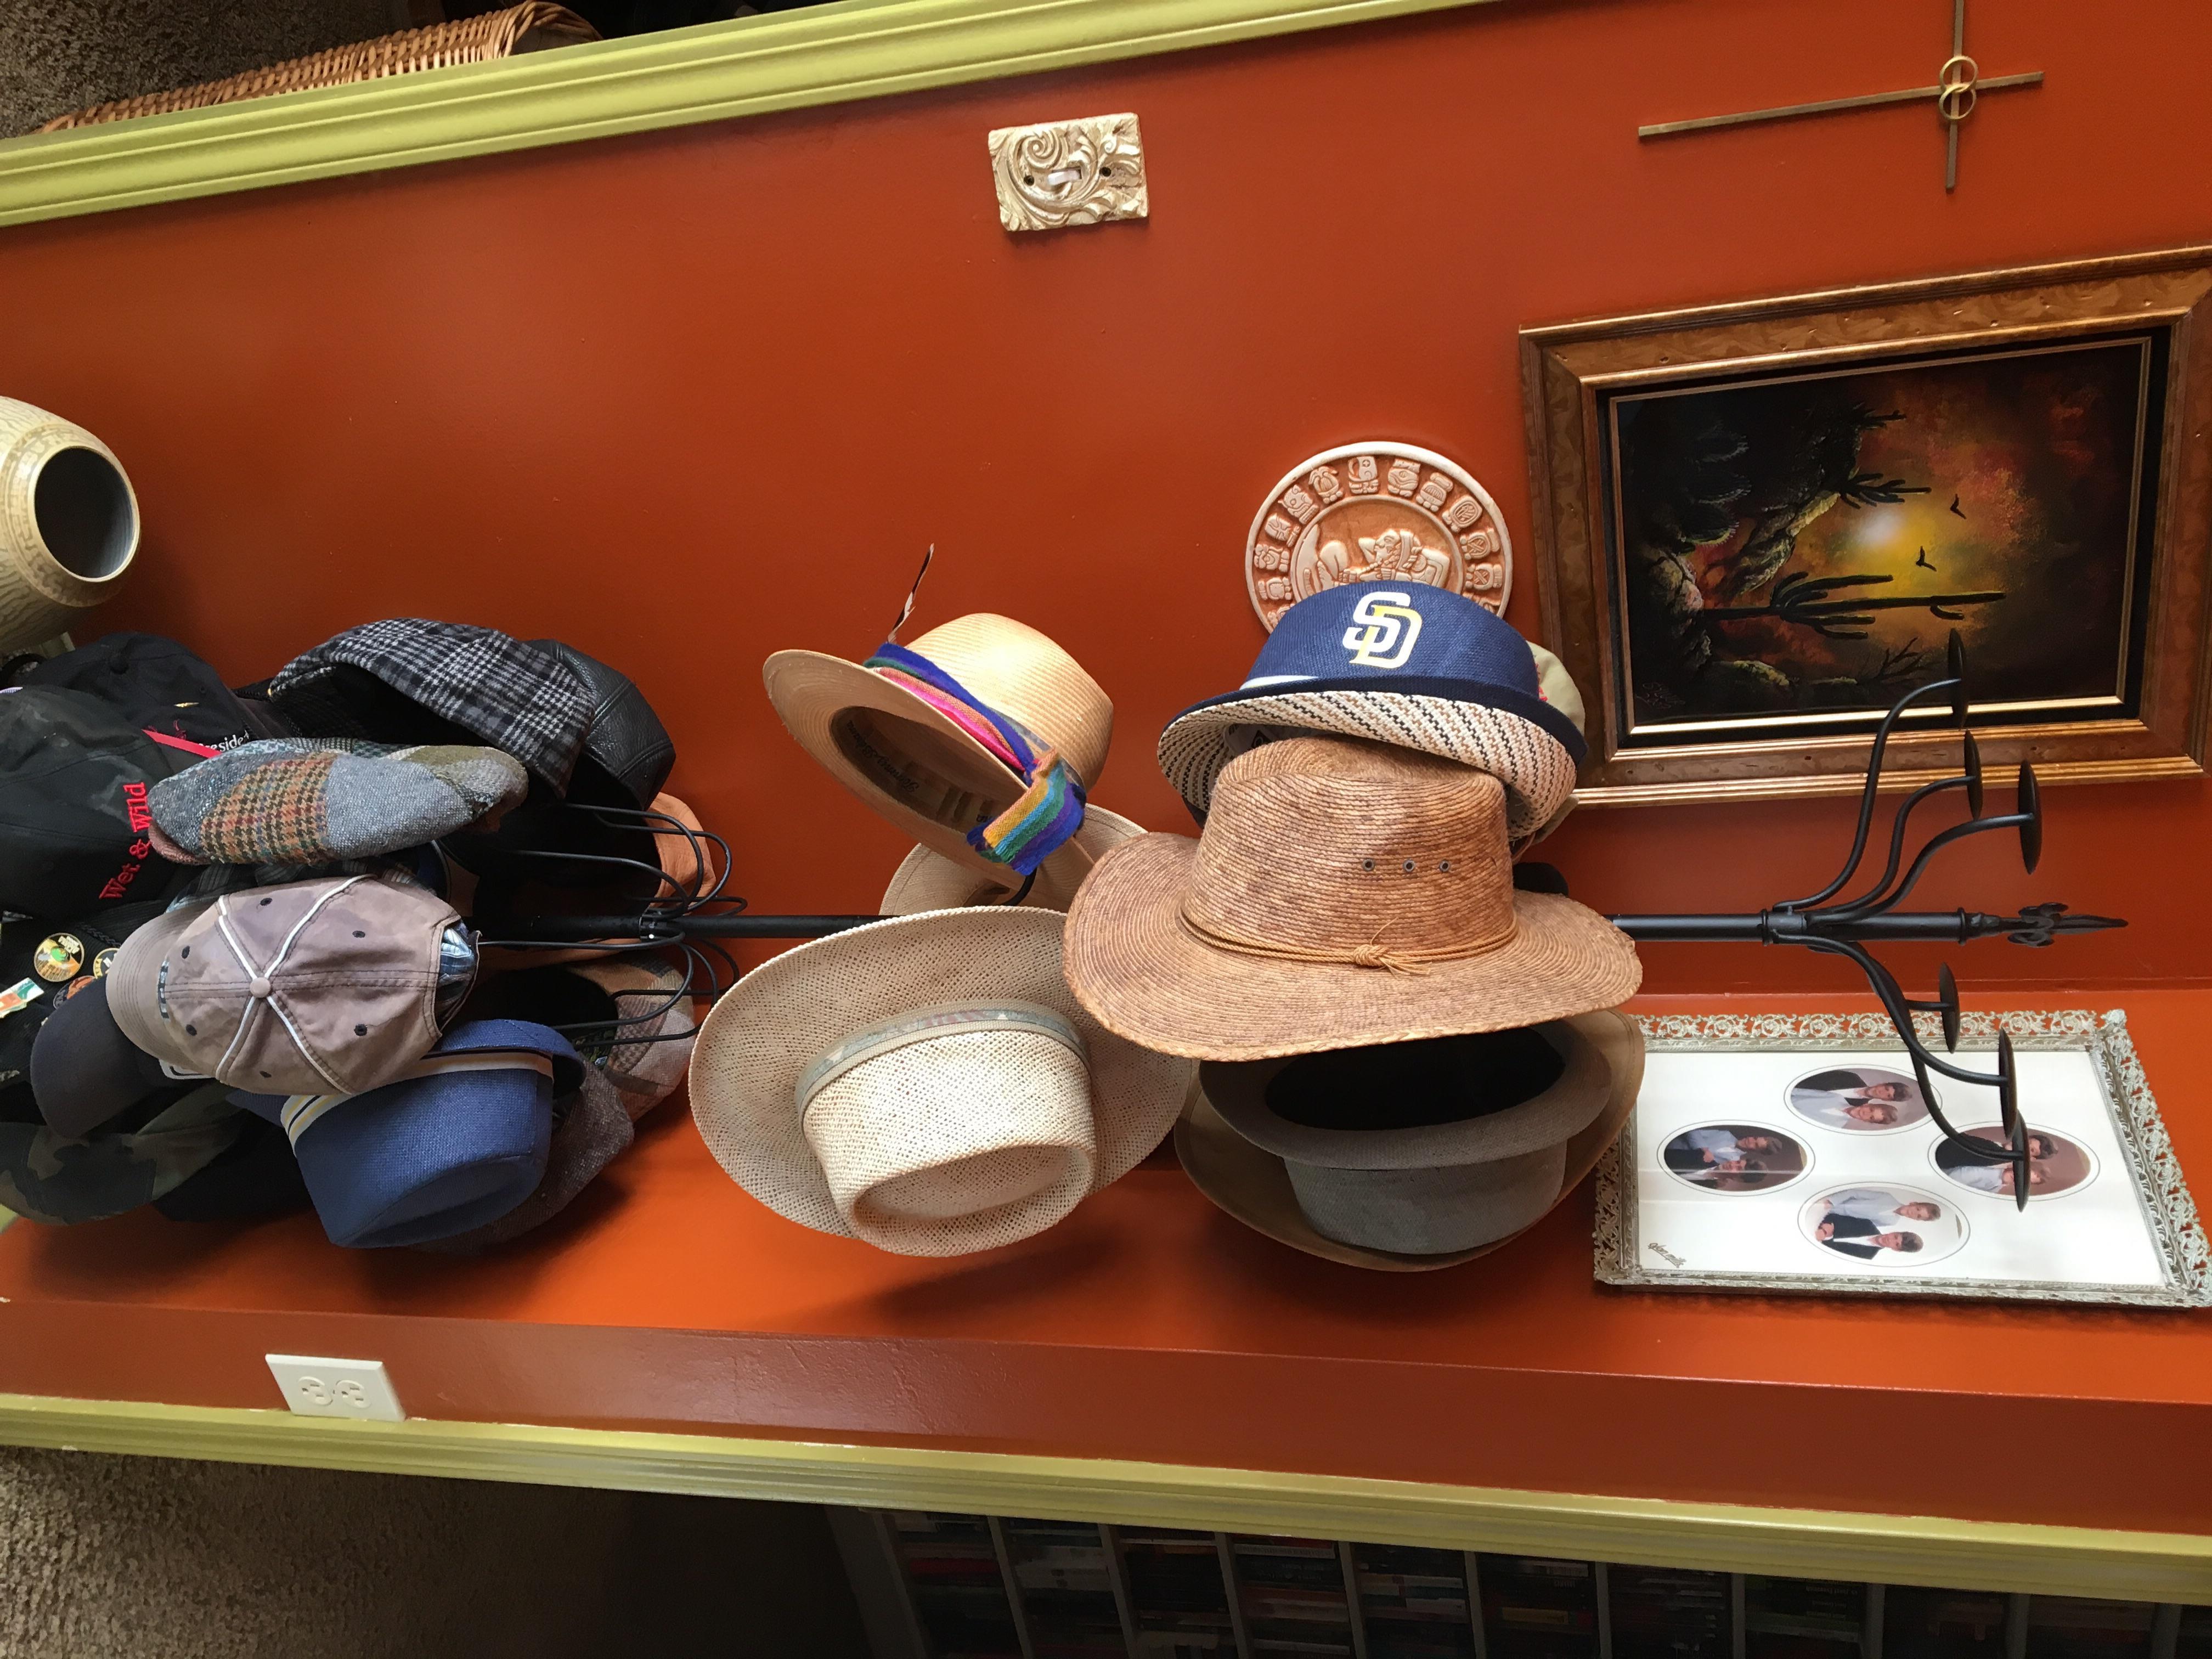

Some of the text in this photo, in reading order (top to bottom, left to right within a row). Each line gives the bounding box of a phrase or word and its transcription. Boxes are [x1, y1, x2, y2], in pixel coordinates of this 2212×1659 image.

[1342, 591, 1423, 669] SD
[98, 781, 153, 899] Wet & Wild
